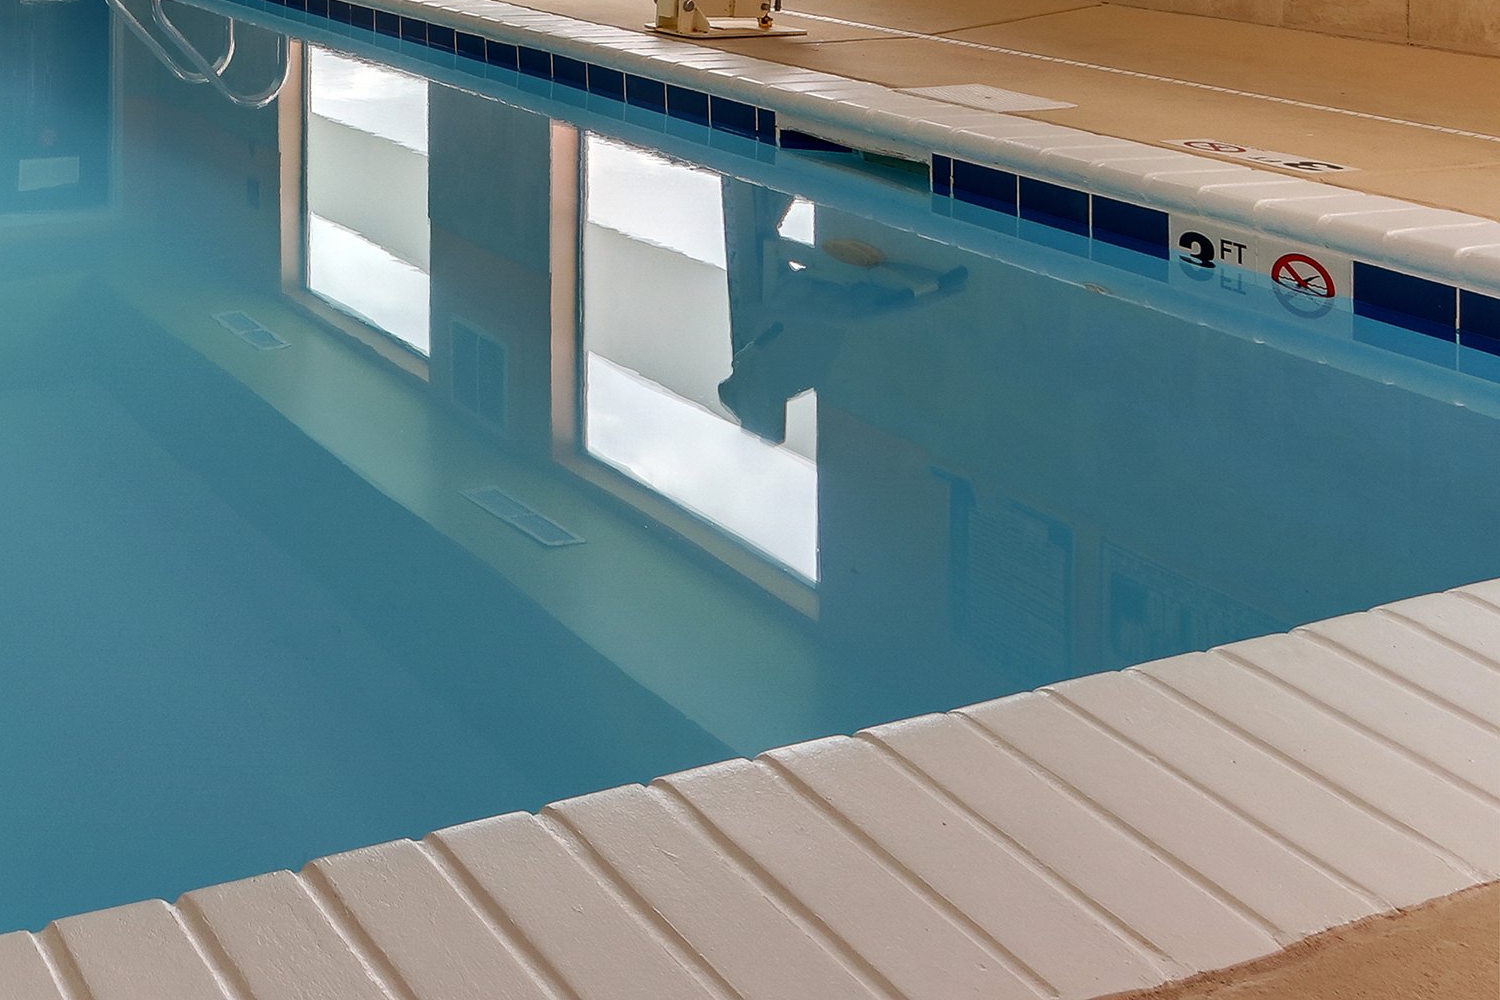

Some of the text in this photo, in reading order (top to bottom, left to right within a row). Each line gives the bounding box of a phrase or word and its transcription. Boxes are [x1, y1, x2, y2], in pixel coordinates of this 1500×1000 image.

[1284, 162, 1343, 172] 3
[1179, 231, 1247, 268] 3 FT
